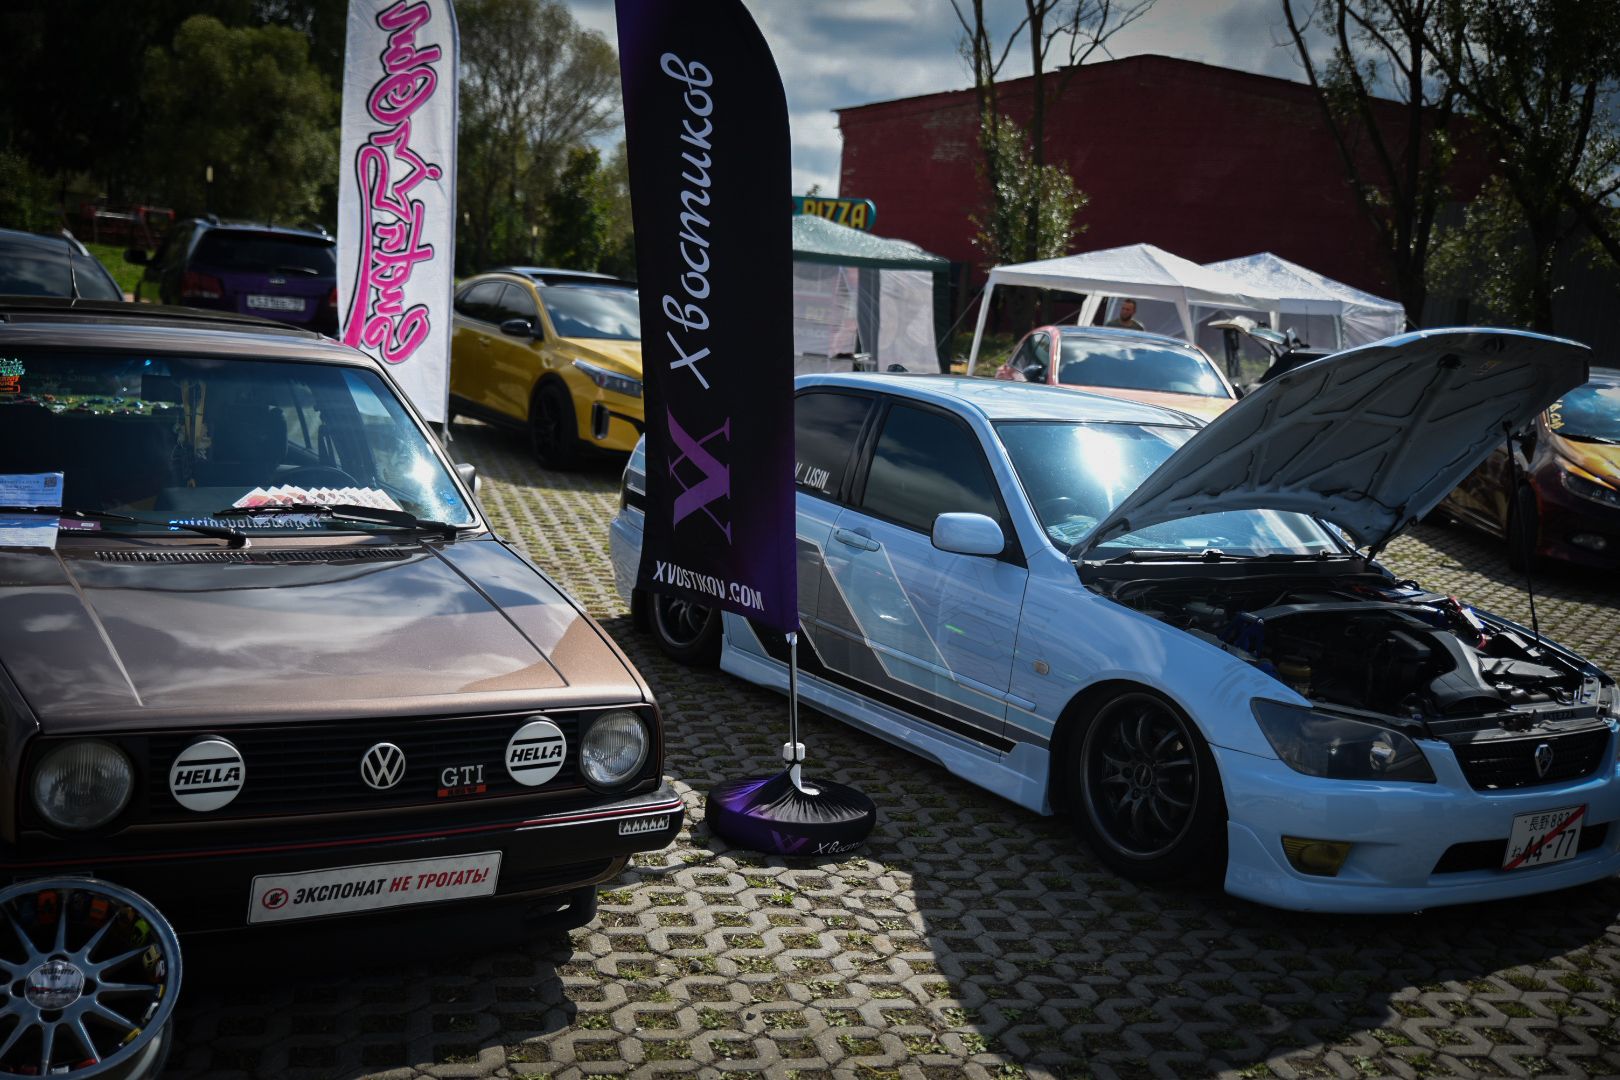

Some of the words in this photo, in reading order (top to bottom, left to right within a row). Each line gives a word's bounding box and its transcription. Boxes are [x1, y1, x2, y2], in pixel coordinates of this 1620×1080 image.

[659, 52, 713, 390] Хвостиков
[802, 198, 866, 230] PIZZA
[509, 744, 563, 763] HELLA
[174, 766, 241, 786] HELLA
[441, 764, 485, 788] GTI
[292, 878, 387, 905] ЭКСПОНАТ
[388, 876, 411, 893] НЕ
[416, 867, 491, 890] ТРОГАТЬ!
